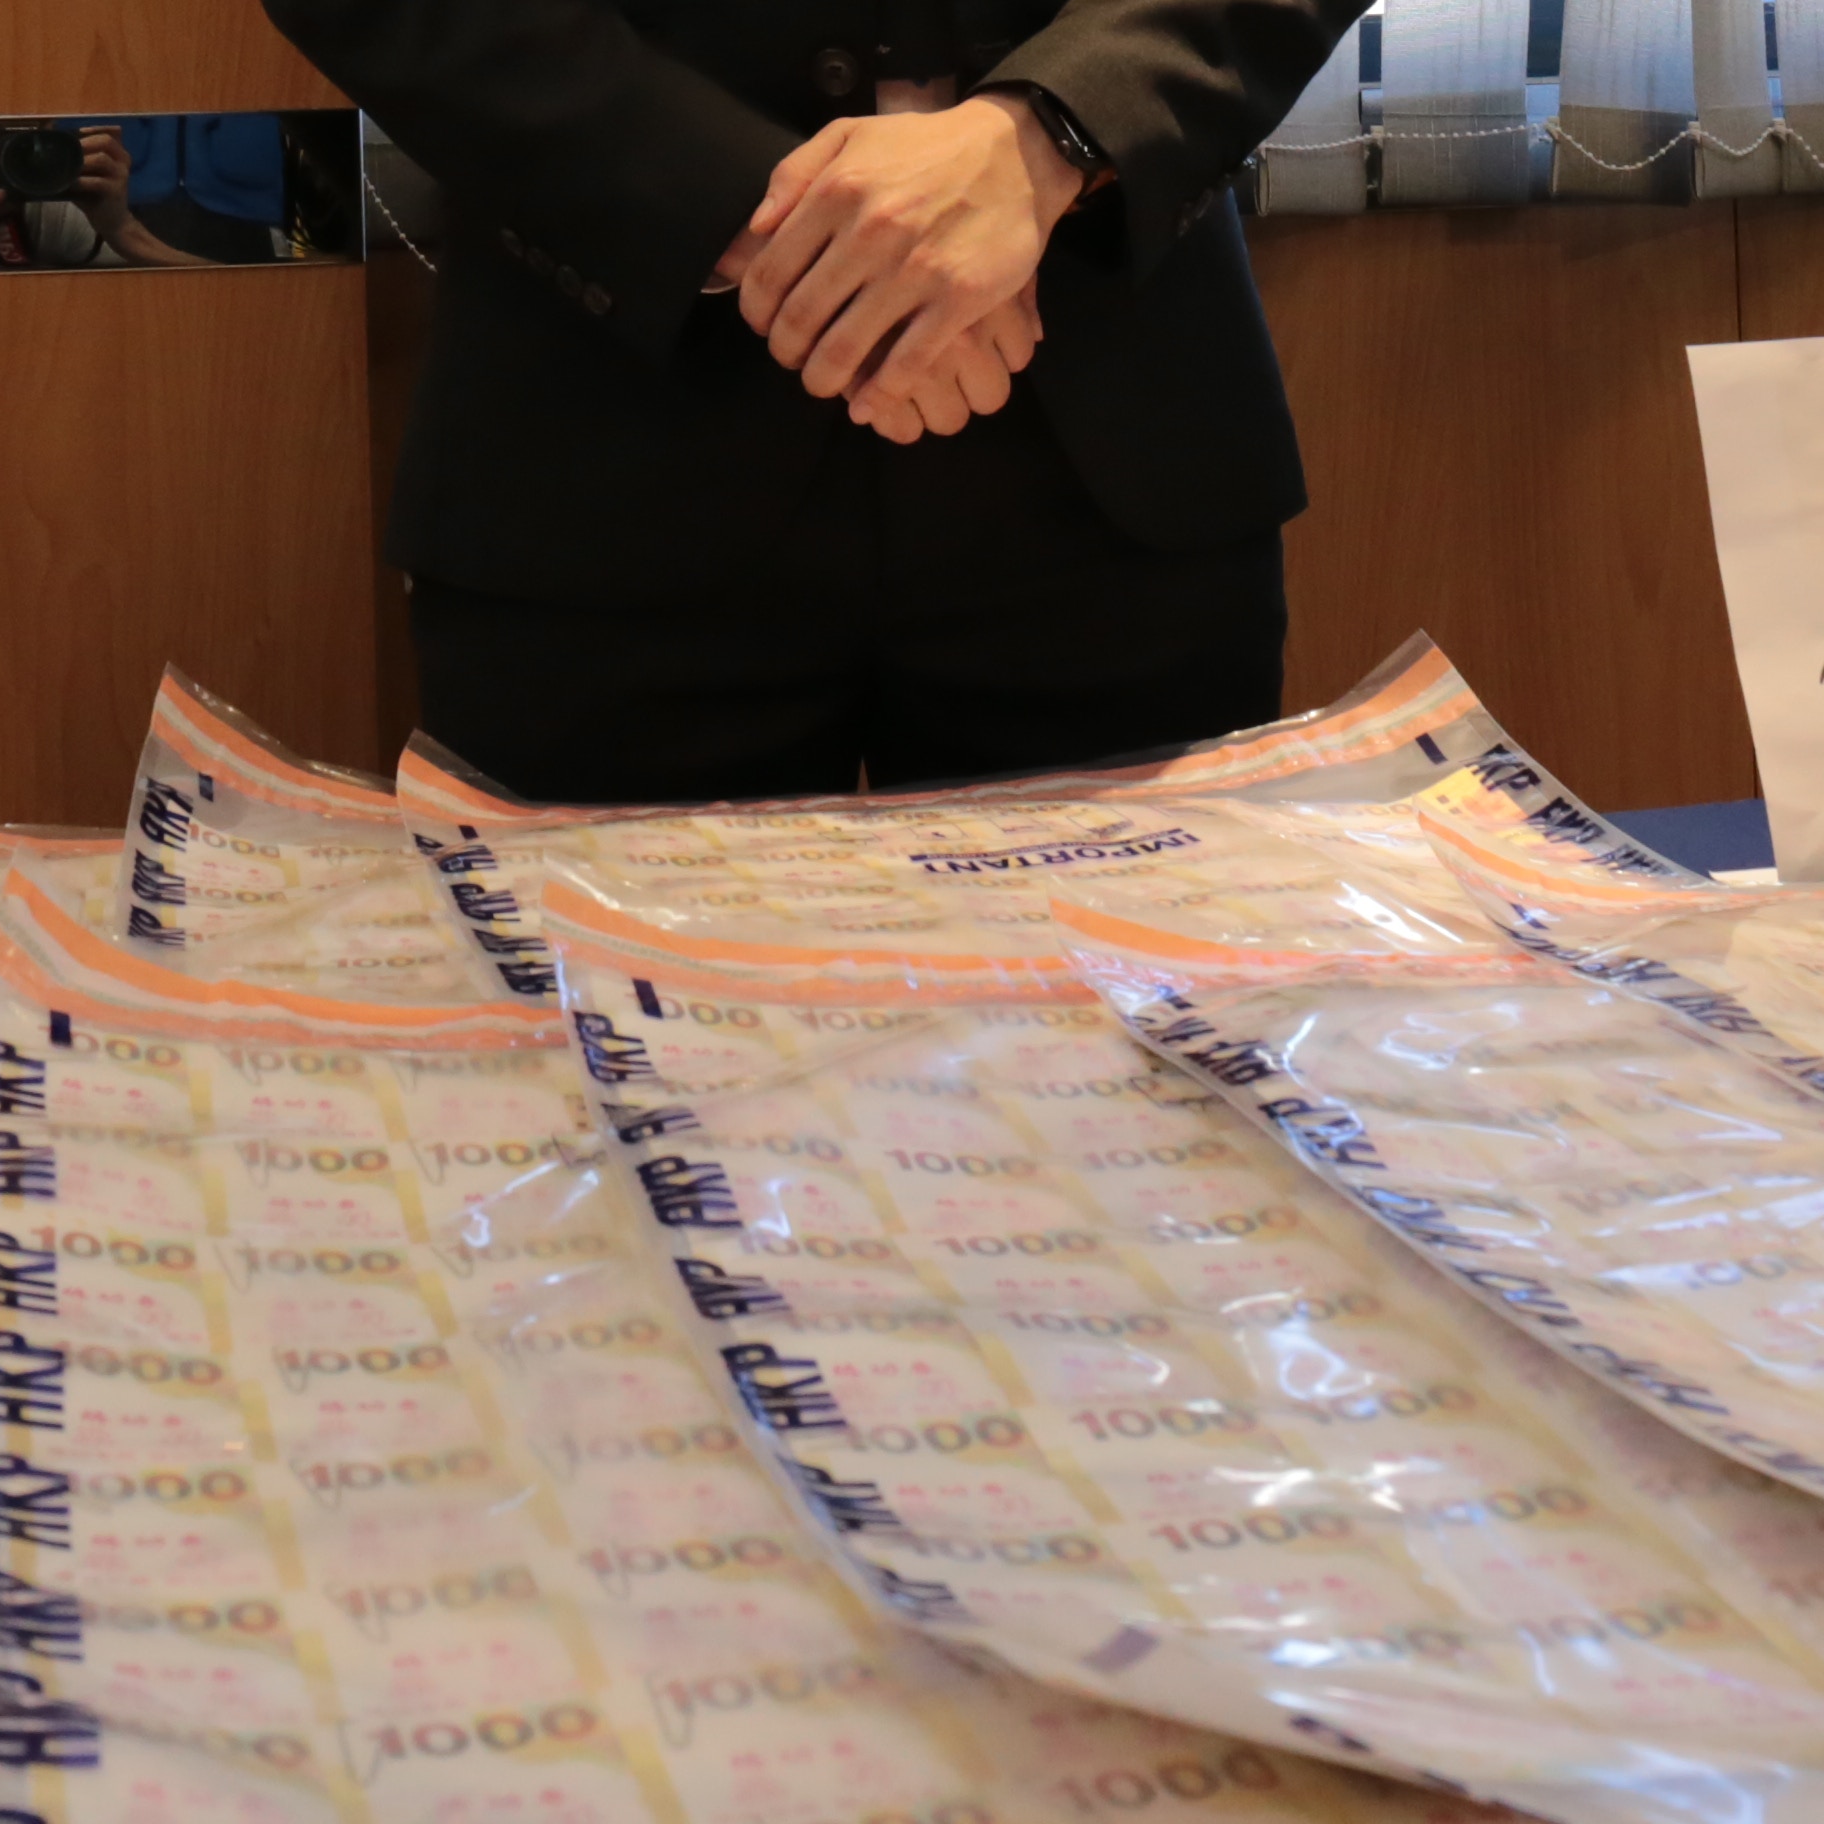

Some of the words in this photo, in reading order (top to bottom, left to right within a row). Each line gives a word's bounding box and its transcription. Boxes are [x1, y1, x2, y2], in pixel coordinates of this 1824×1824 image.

[189, 823, 281, 860] 1000
[922, 831, 1202, 875] IMPORTANT
[624, 851, 728, 868] 1000
[240, 1140, 390, 1174] 1000
[885, 1146, 1037, 1177] 1000
[30, 1224, 197, 1273] 1000
[240, 1246, 402, 1277] 1000
[934, 1229, 1099, 1261] 1000
[1000, 1309, 1172, 1337] 1000
[281, 1345, 450, 1377] 1000
[298, 1451, 492, 1491] 1000
[1148, 1508, 1354, 1554] 1000
[583, 1535, 783, 1576] 1000
[370, 1705, 599, 1760] 1000
